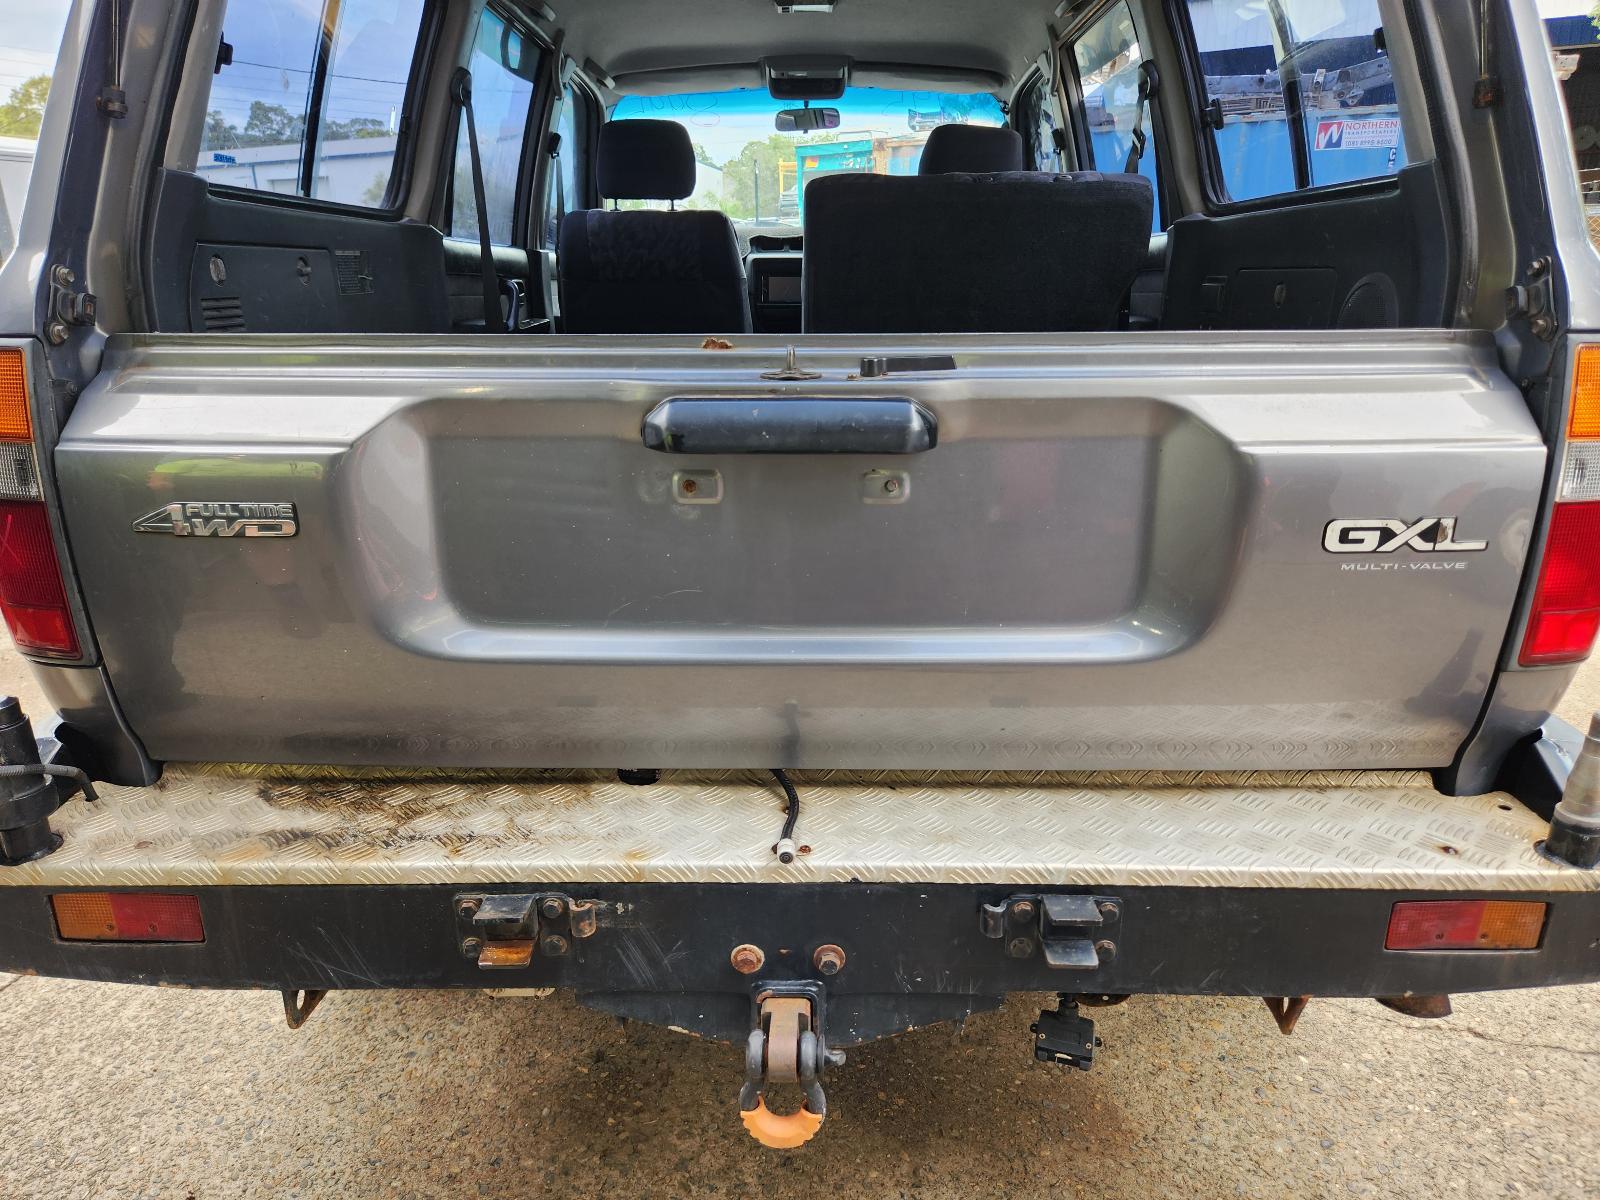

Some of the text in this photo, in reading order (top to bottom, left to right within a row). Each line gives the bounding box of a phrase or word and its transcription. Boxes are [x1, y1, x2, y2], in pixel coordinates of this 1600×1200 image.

[1345, 121, 1398, 130] NORTHERN
[185, 504, 294, 518] FULL TIME
[132, 503, 297, 536] 4WD
[1321, 516, 1489, 553] GXL
[1340, 562, 1467, 571] MULTI-VALVE
